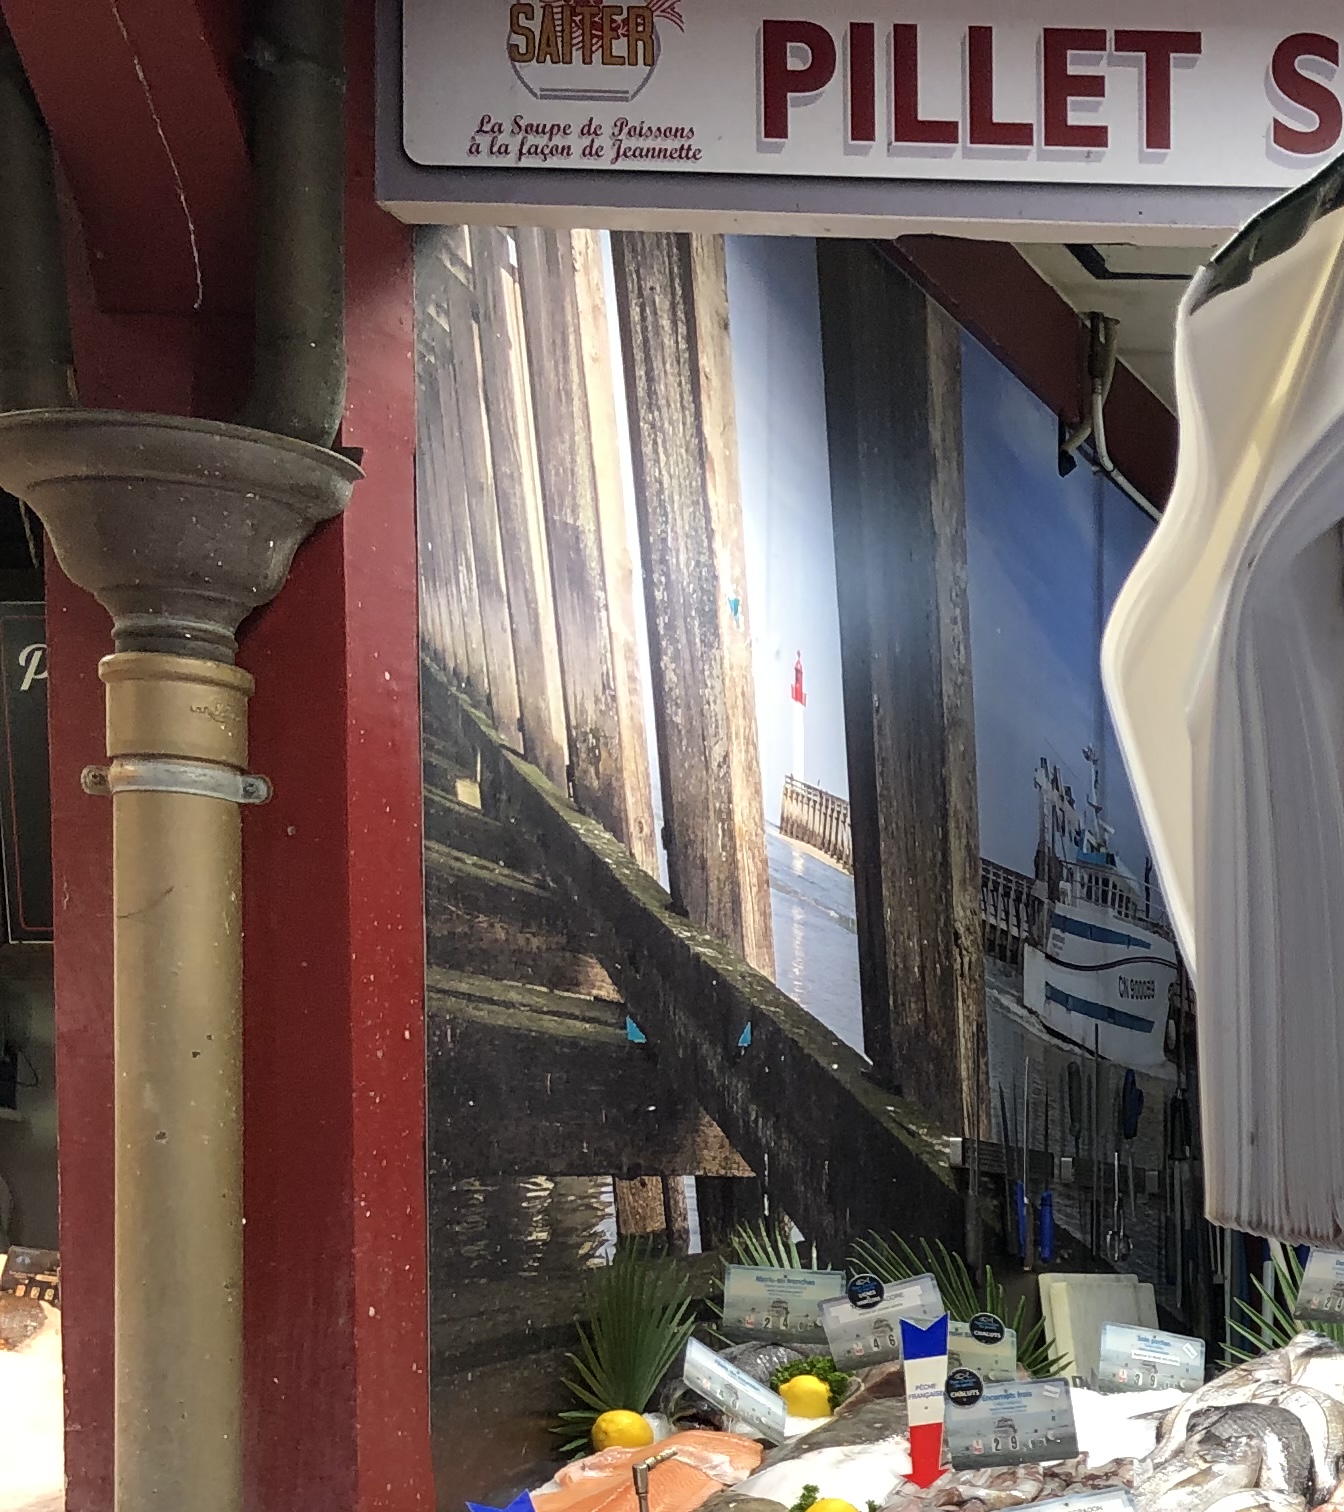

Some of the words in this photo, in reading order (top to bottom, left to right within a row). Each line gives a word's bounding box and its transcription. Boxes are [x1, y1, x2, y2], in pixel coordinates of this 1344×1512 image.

[508, 2, 655, 67] SAITER
[762, 19, 1202, 150] PILLET
[476, 114, 504, 136] La
[510, 115, 573, 141] Soupe
[581, 117, 603, 137] de
[611, 117, 695, 139] Poissons
[468, 137, 481, 155] à
[489, 137, 510, 156] la
[518, 138, 574, 163] façon
[582, 139, 605, 158] de
[610, 139, 703, 164] Jeannette
[949, 1388, 980, 1398] CHALUTS
